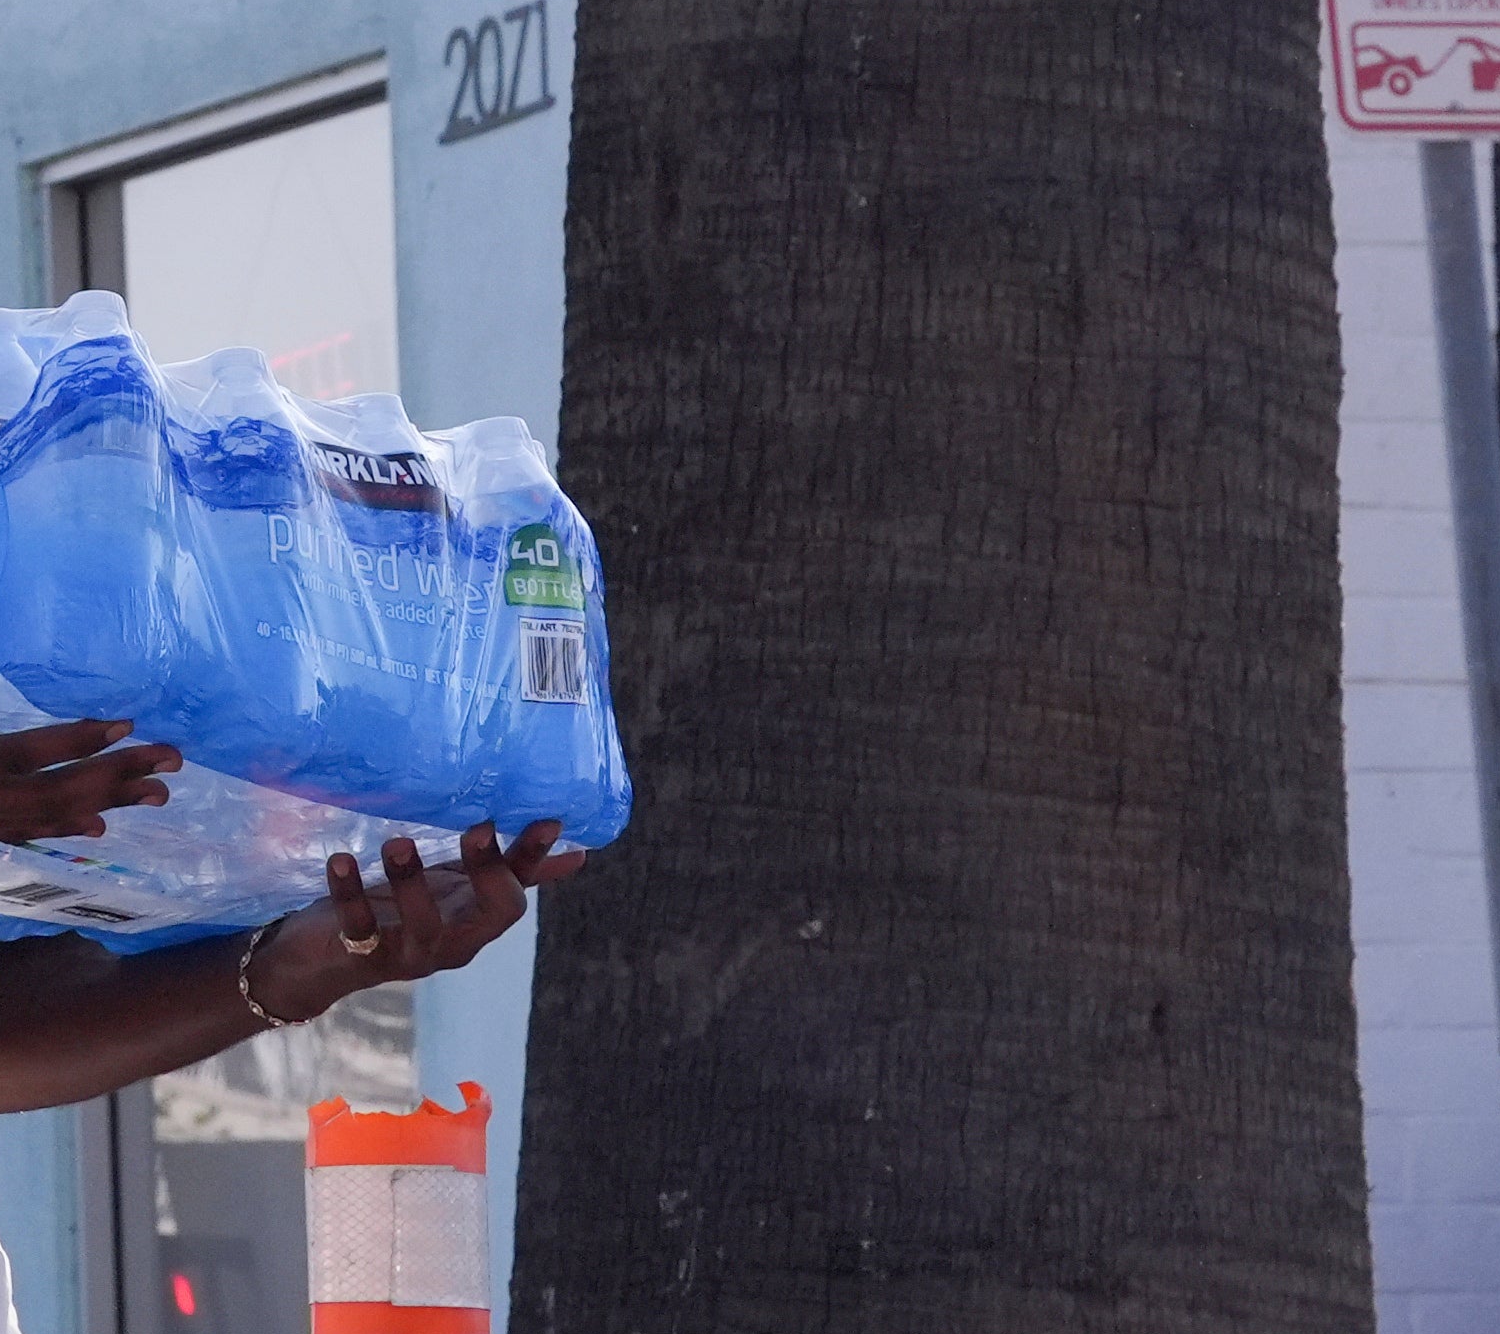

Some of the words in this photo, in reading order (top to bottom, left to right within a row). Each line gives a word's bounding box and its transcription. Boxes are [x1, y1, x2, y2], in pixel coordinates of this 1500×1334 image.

[314, 447, 437, 488] IRKLAN
[511, 538, 559, 567] 40
[513, 576, 584, 601] BOTTLE
[385, 602, 436, 625] added
